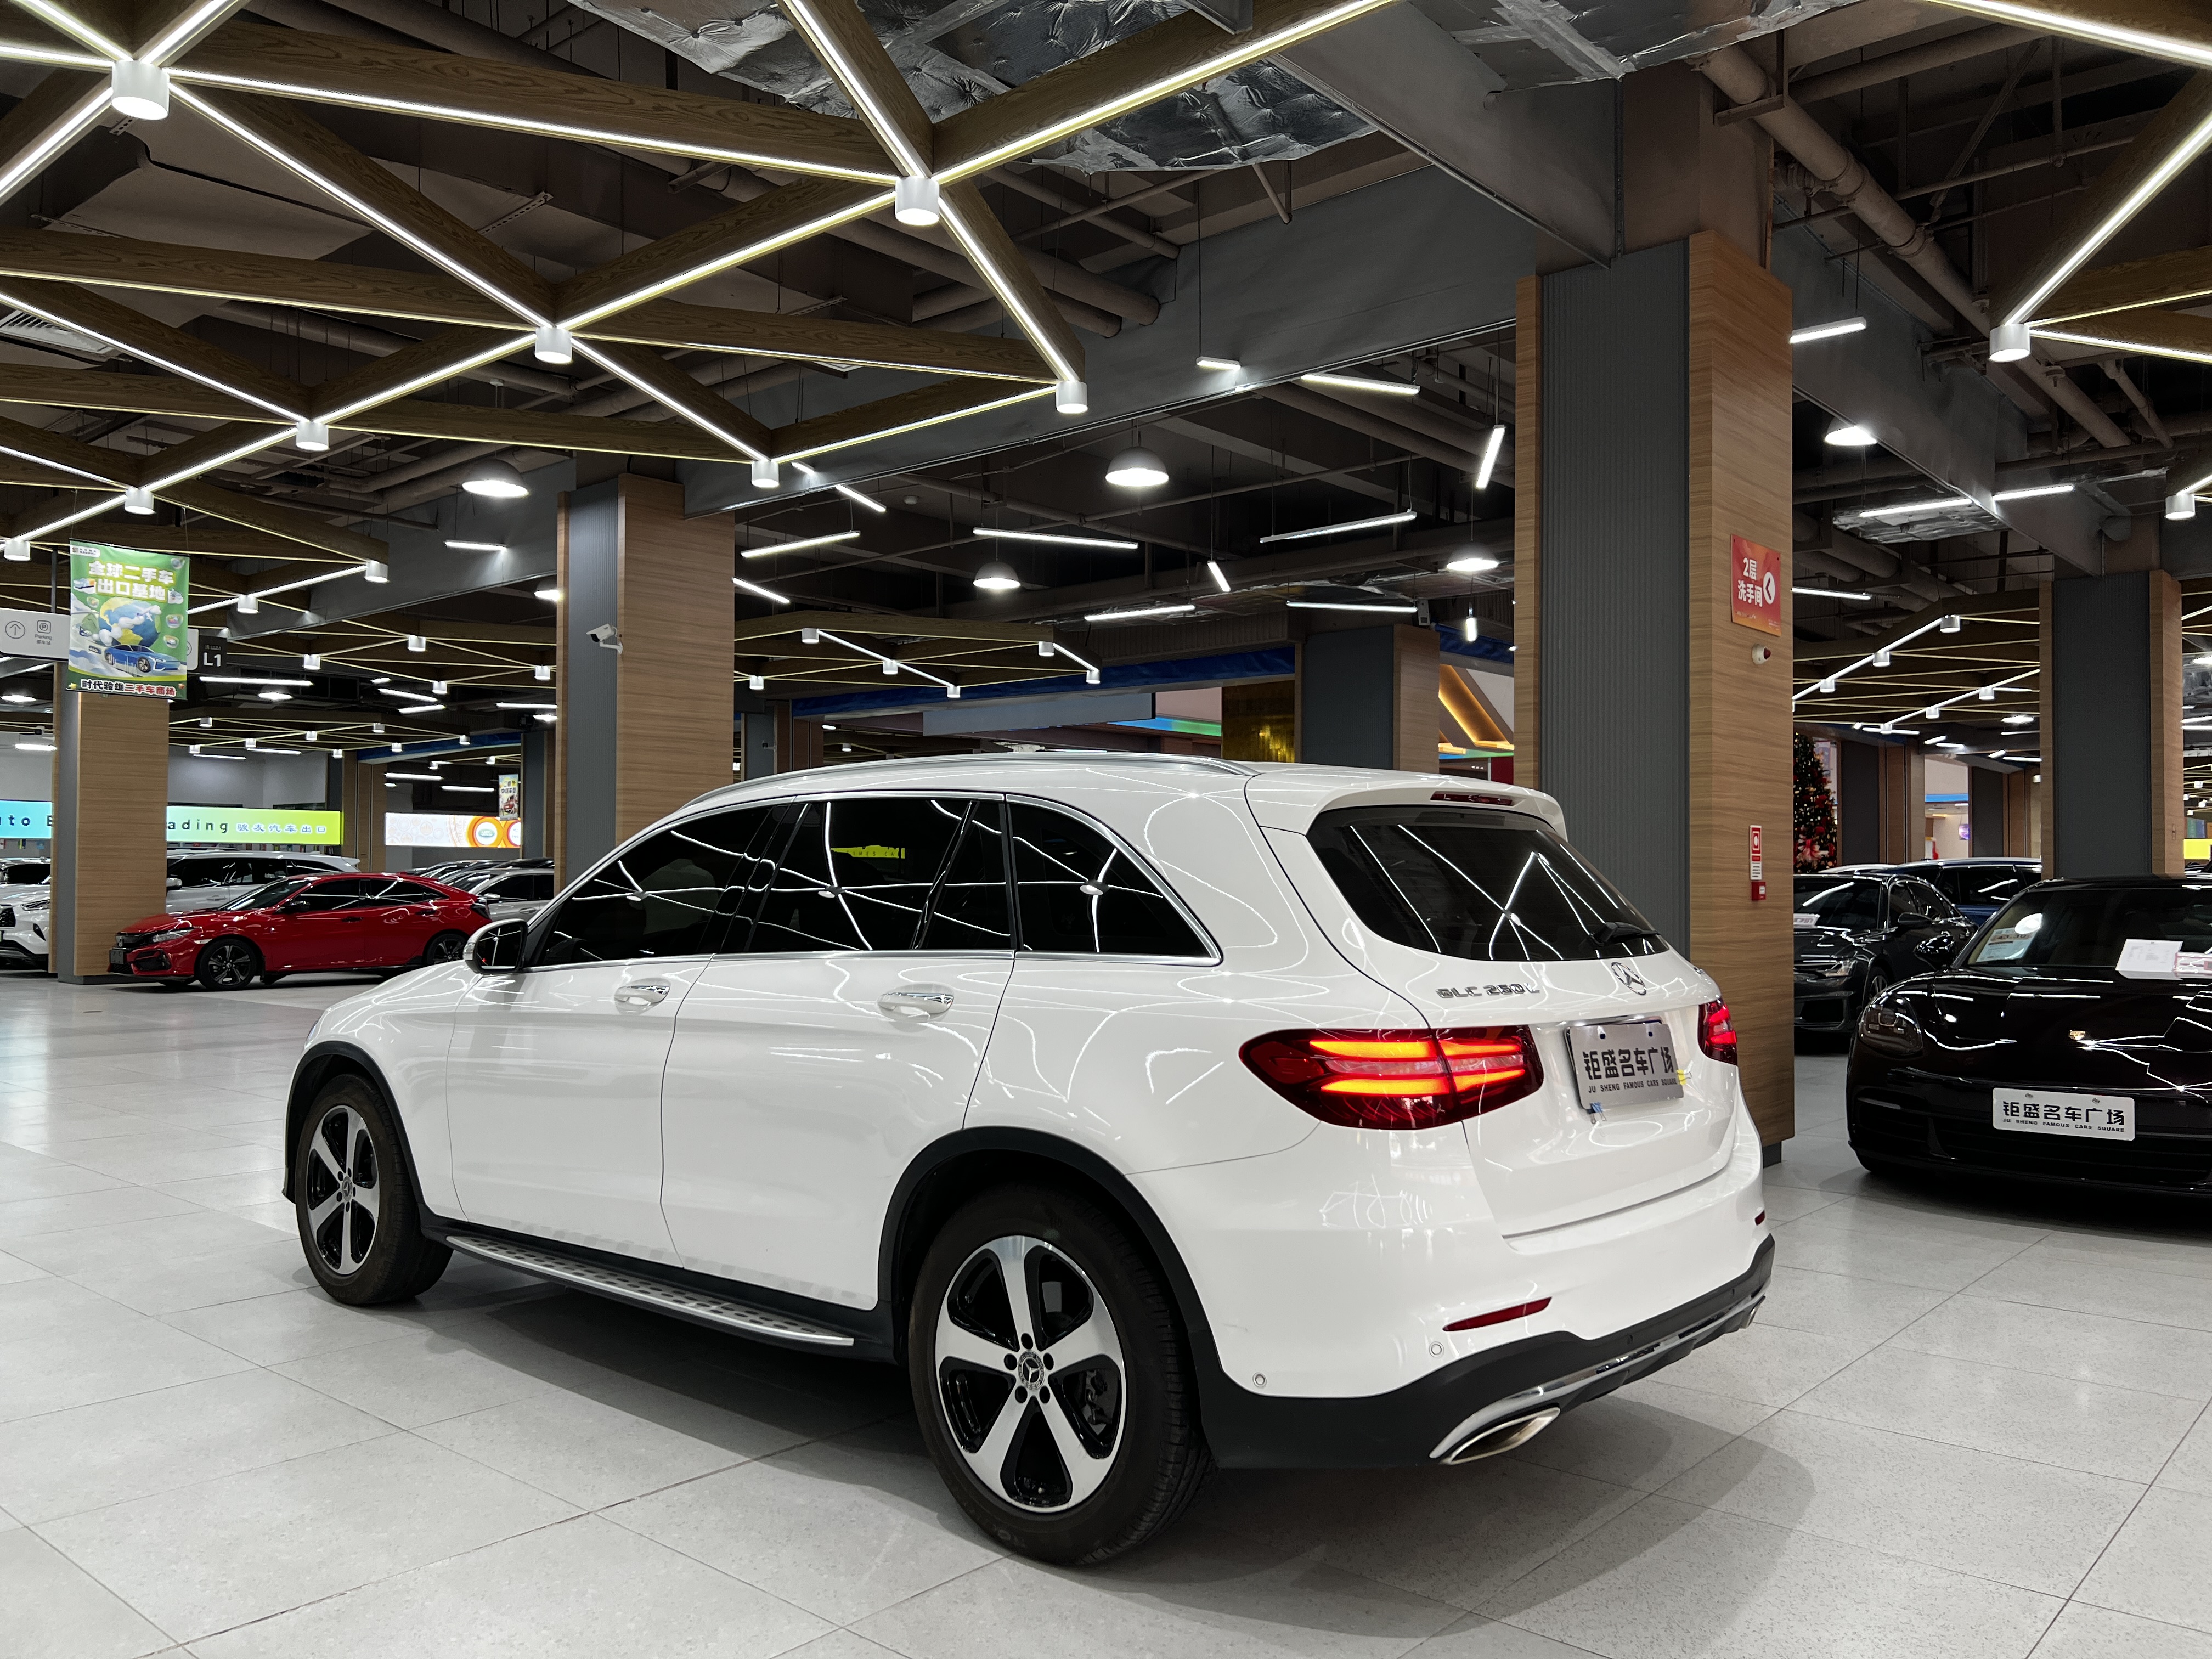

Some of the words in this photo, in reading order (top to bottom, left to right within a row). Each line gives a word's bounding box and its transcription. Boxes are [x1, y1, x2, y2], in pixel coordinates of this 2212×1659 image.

[88, 560, 174, 585] 全球二手车
[1743, 557, 1757, 581] 2层
[98, 578, 165, 601] 出口基地
[1737, 579, 1763, 607] 洗手间
[204, 652, 221, 667] L1
[0, 814, 31, 826] to
[237, 823, 326, 833] 骏友汽车出口
[1436, 986, 1482, 998] GLC
[1582, 1046, 1674, 1080] 钜盛名车广场
[1588, 1085, 1596, 1093] JU
[1600, 1083, 1620, 1092] SHENG
[1623, 1081, 1644, 1090] FAMOUS
[1662, 1077, 1678, 1086] SQUARE
[2002, 1101, 2125, 1125] 钜盛名车广场
